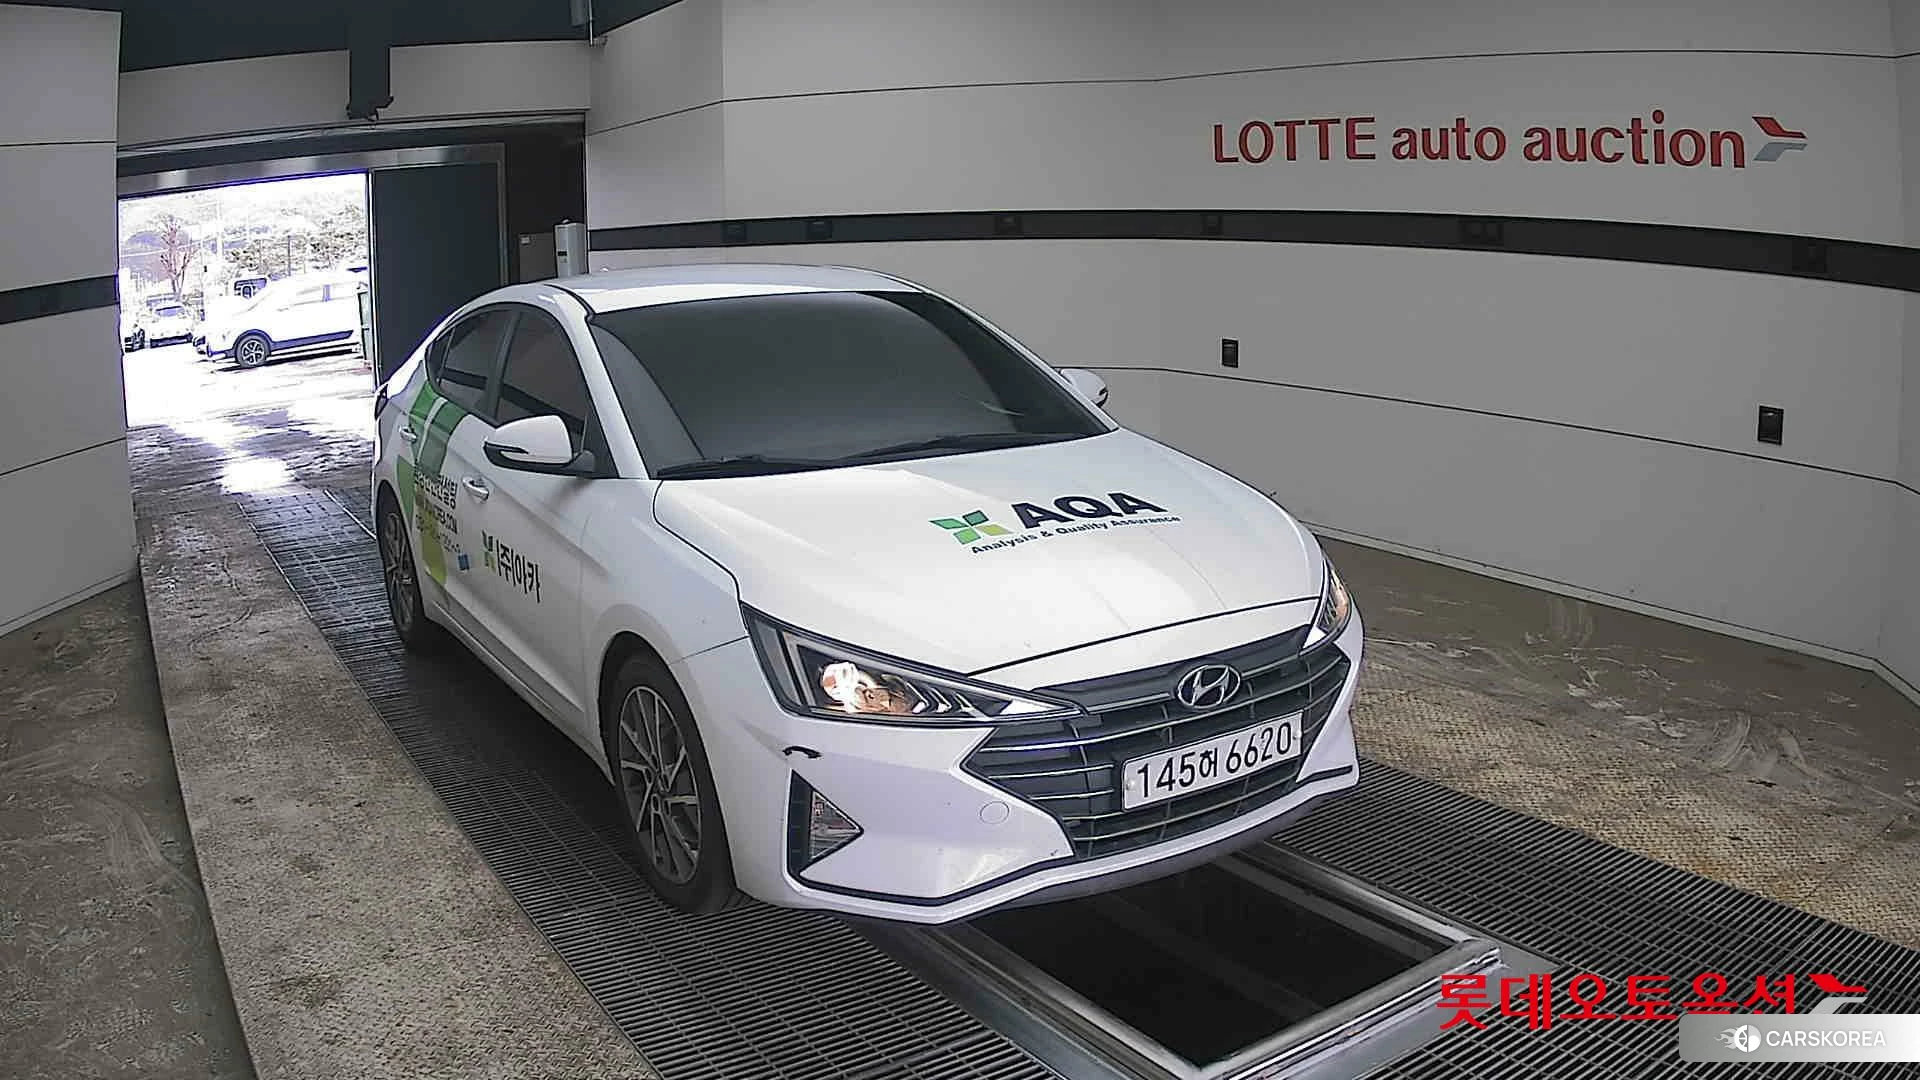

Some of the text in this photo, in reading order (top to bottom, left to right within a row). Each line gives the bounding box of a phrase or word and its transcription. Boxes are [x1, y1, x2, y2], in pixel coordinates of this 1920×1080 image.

[1213, 110, 1746, 168] LOTTE auto auction
[1011, 492, 1168, 529] AQA
[971, 533, 1037, 554] Analysis
[1056, 521, 1108, 536] Quality
[1111, 516, 1181, 527] Assurance
[1137, 722, 1292, 798] 145허 6620
